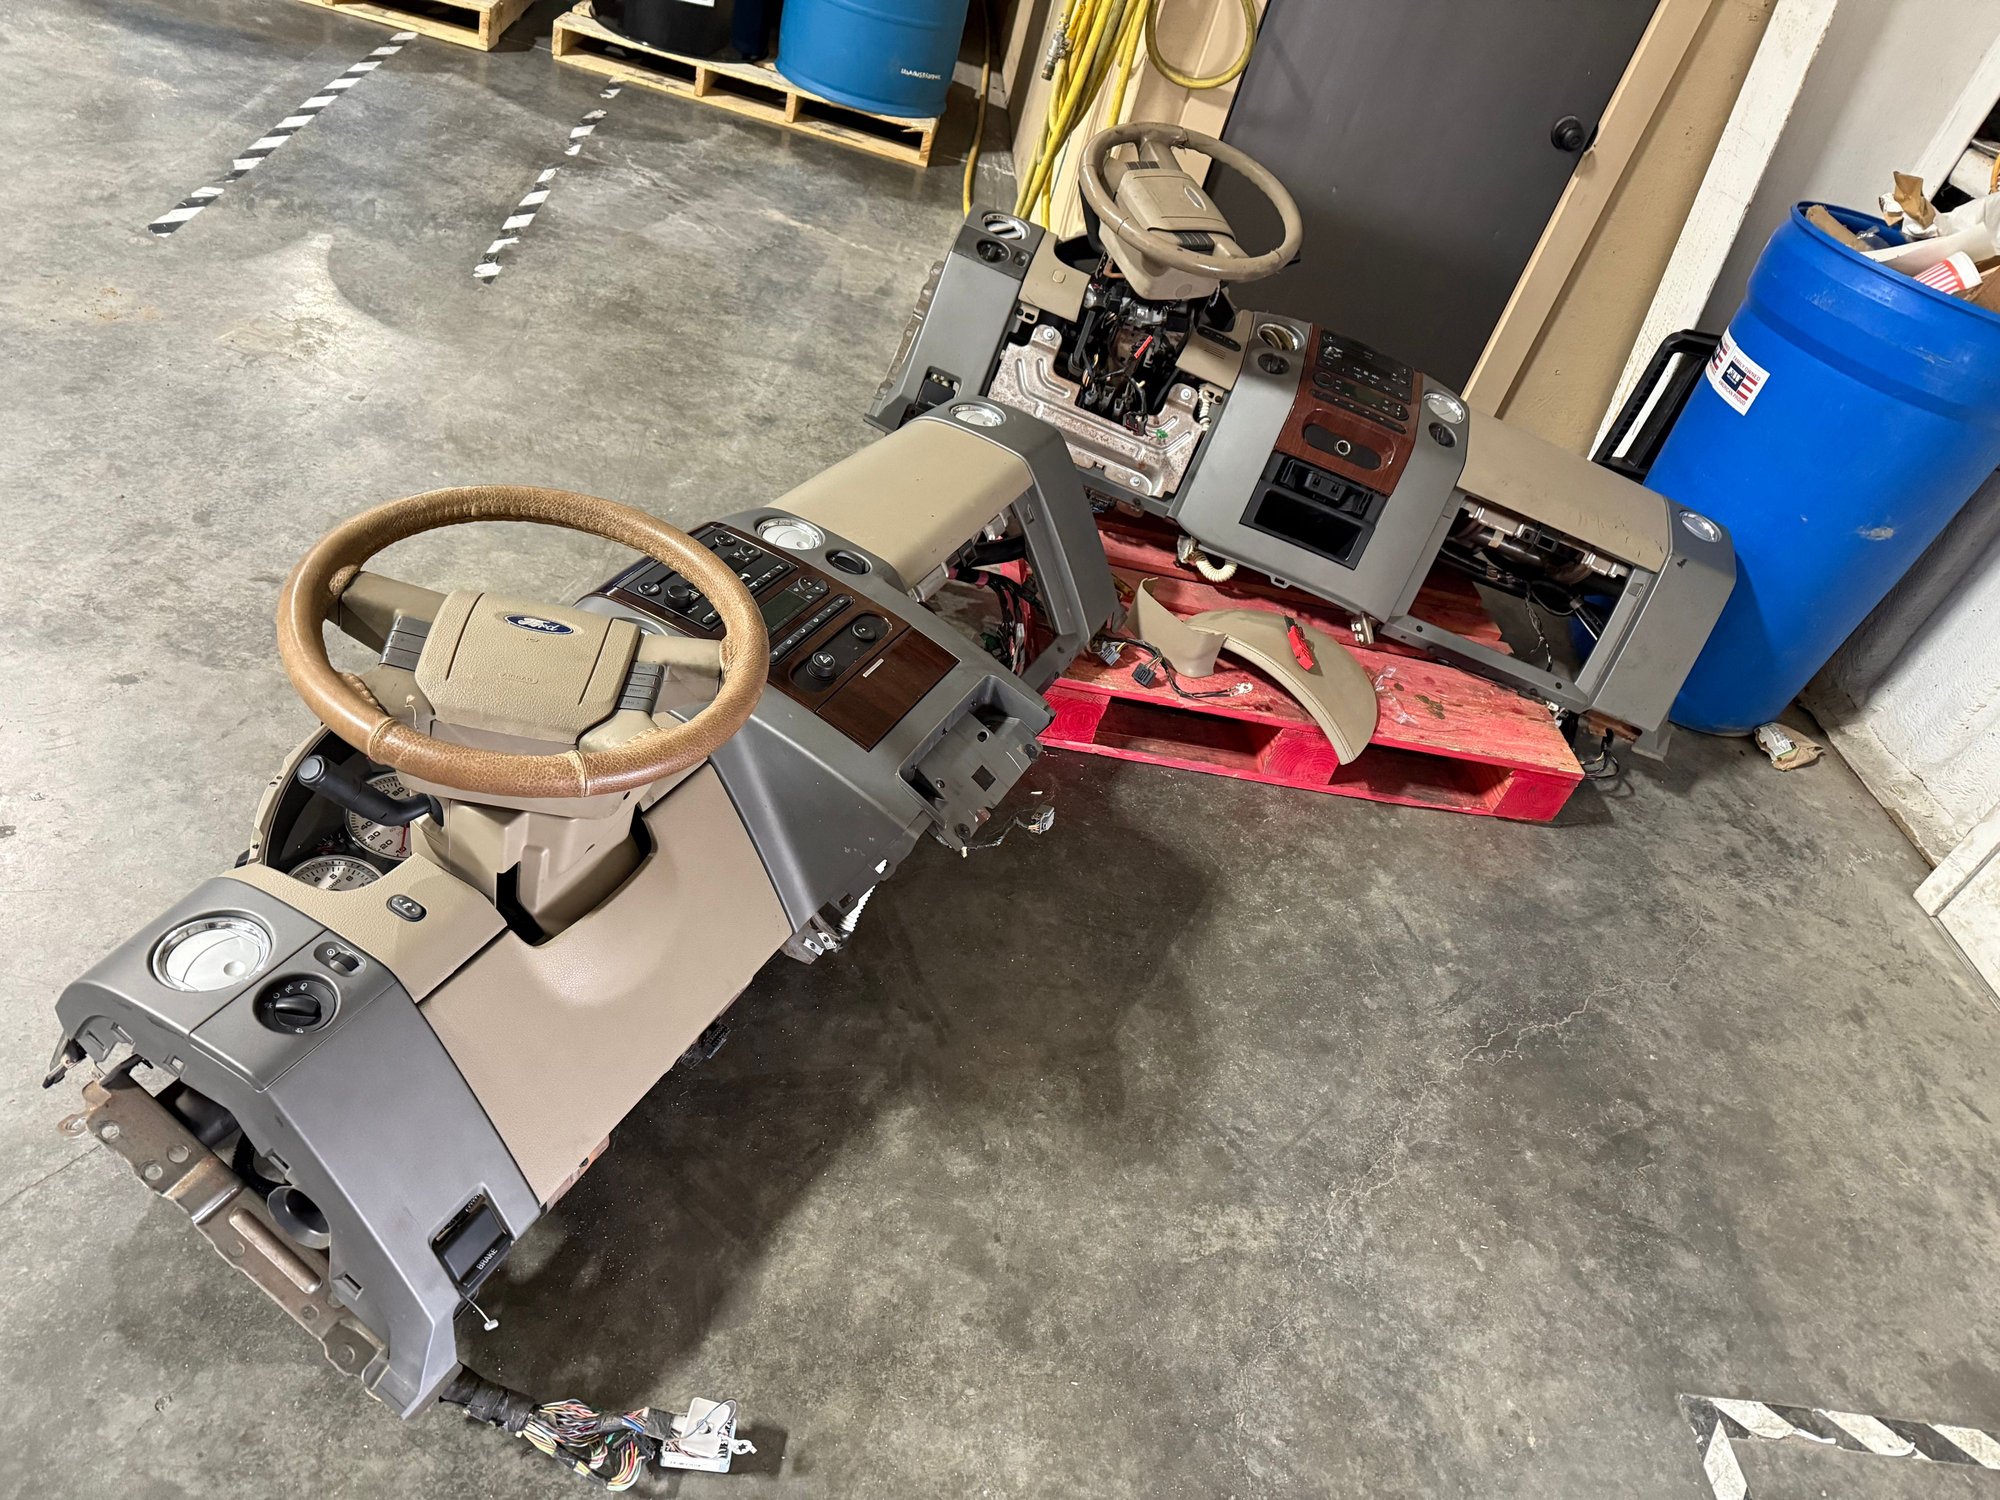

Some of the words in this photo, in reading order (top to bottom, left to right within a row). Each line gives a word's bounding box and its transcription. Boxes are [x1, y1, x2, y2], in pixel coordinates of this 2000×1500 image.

[1733, 355, 1746, 369] FAMILY
[1745, 366, 1761, 382] OWNED
[361, 820, 373, 830] 40
[367, 830, 381, 841] 30
[380, 839, 393, 850] 20
[476, 1247, 498, 1270] BRAKE
